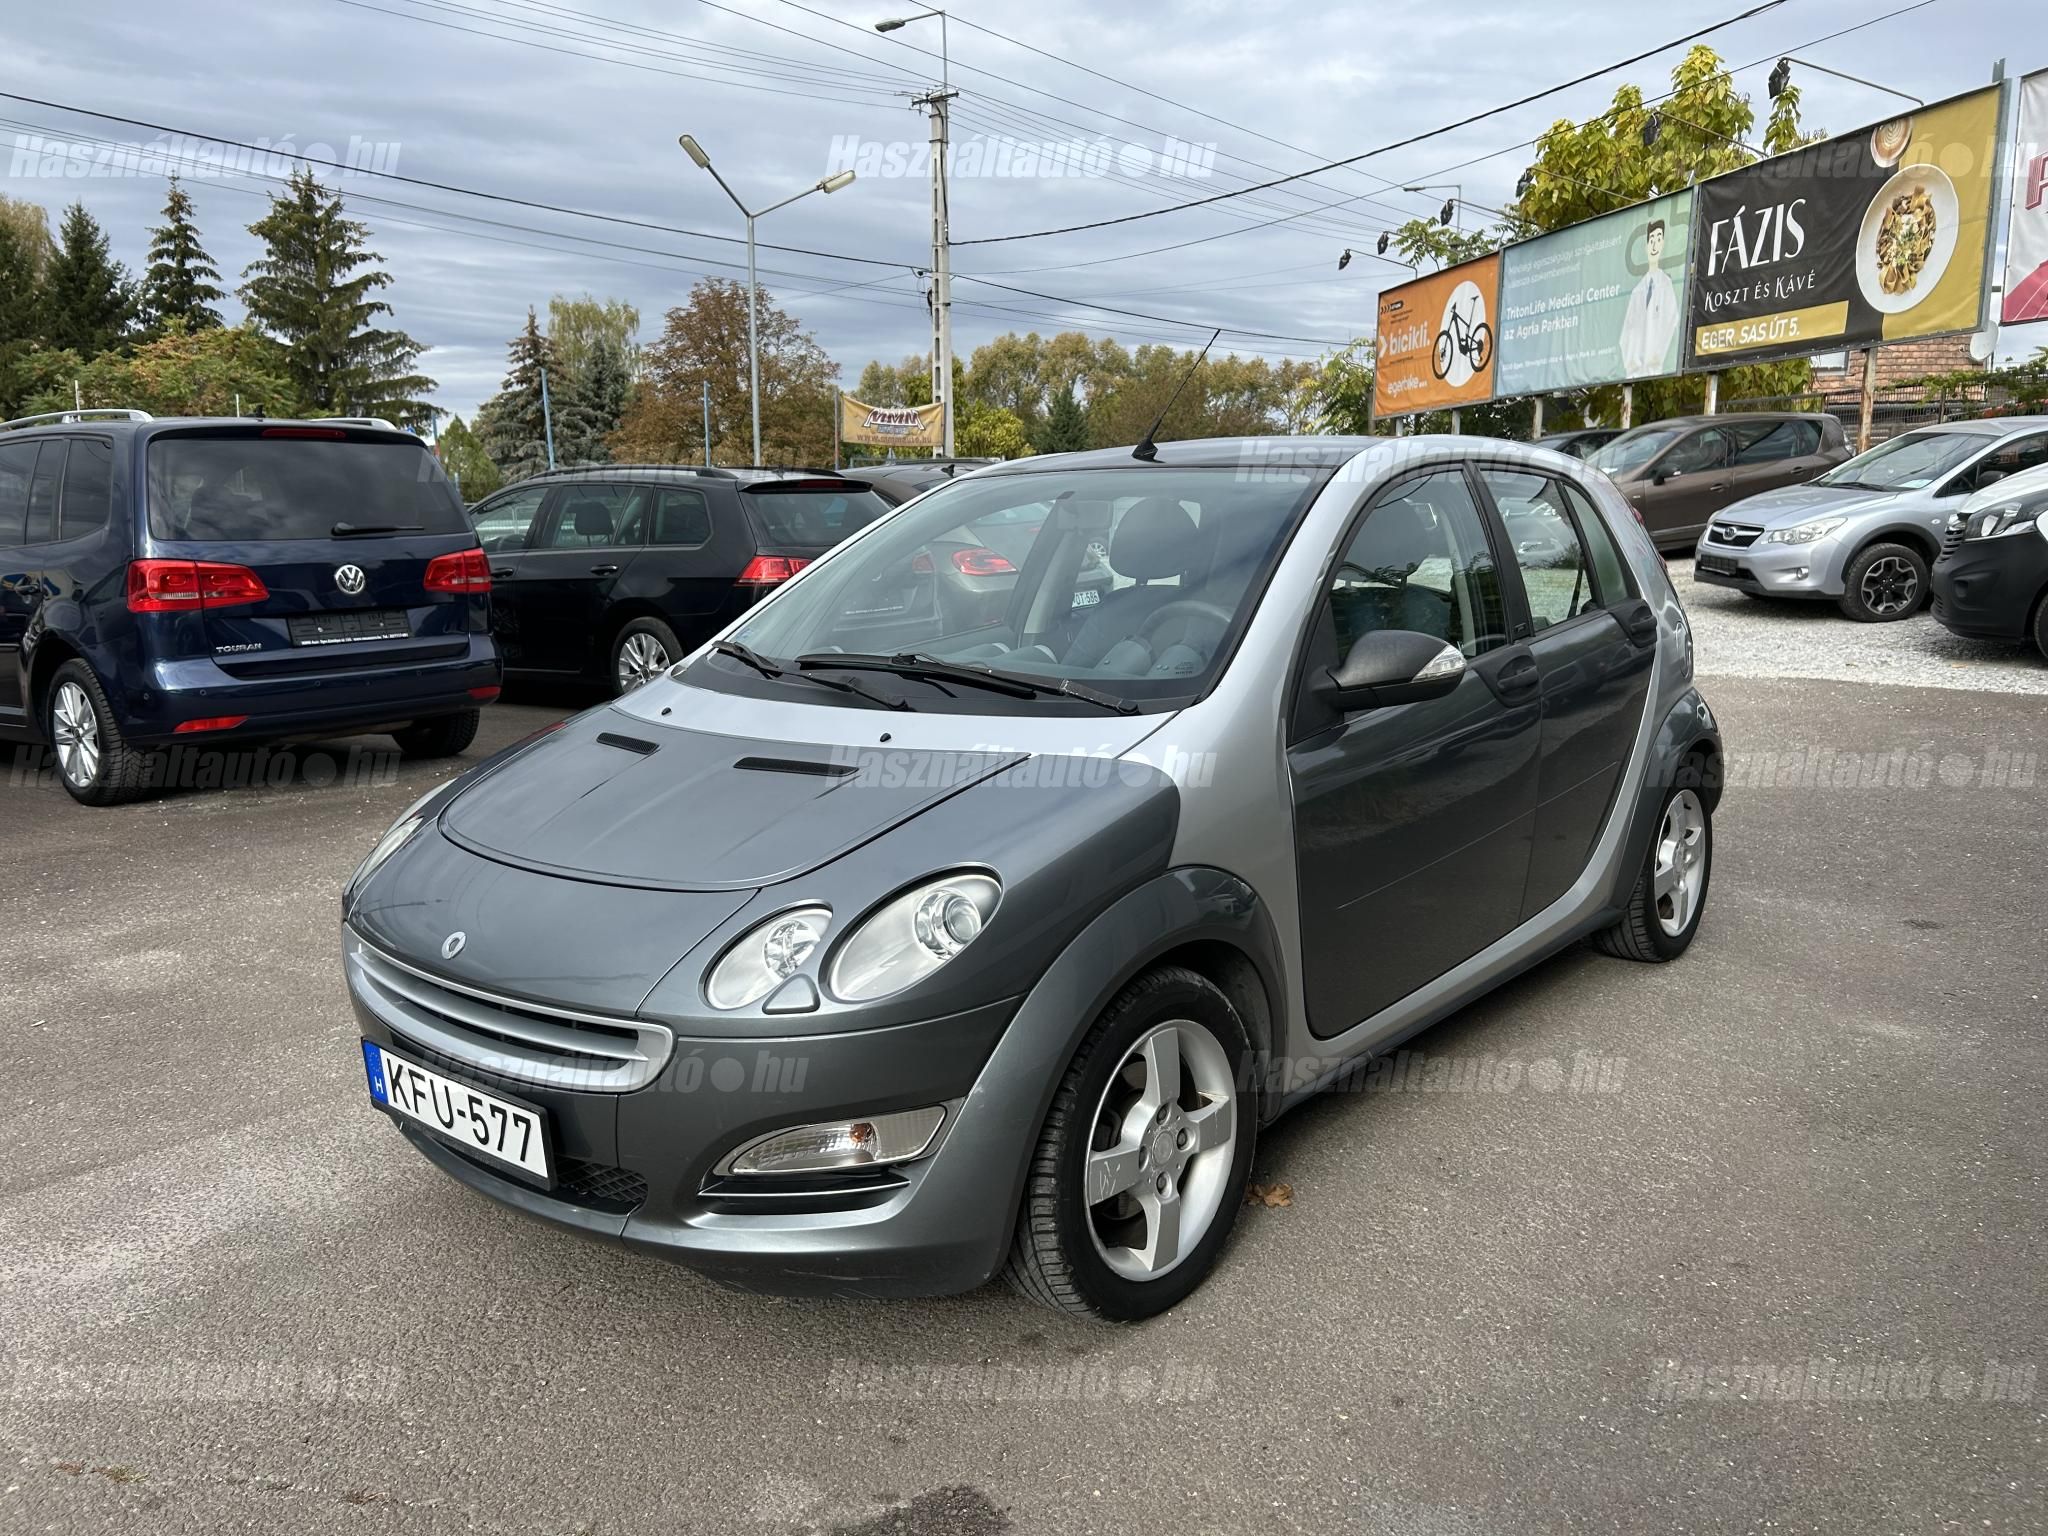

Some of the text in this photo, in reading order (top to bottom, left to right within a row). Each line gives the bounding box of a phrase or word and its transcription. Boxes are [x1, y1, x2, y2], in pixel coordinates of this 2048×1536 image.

[1707, 198, 1806, 277] FÁZIS
[1506, 284, 1621, 321] TritonLife Medical Center
[1754, 281, 1770, 300] ÉS
[1504, 315, 1578, 340] az Agria Parkban
[1739, 323, 1766, 344] SAS
[1769, 315, 1789, 339] ÚT
[1789, 317, 1800, 336] 5.
[216, 642, 262, 653] TOURAN
[374, 1076, 384, 1094] H
[386, 1057, 532, 1163] KFU-577
